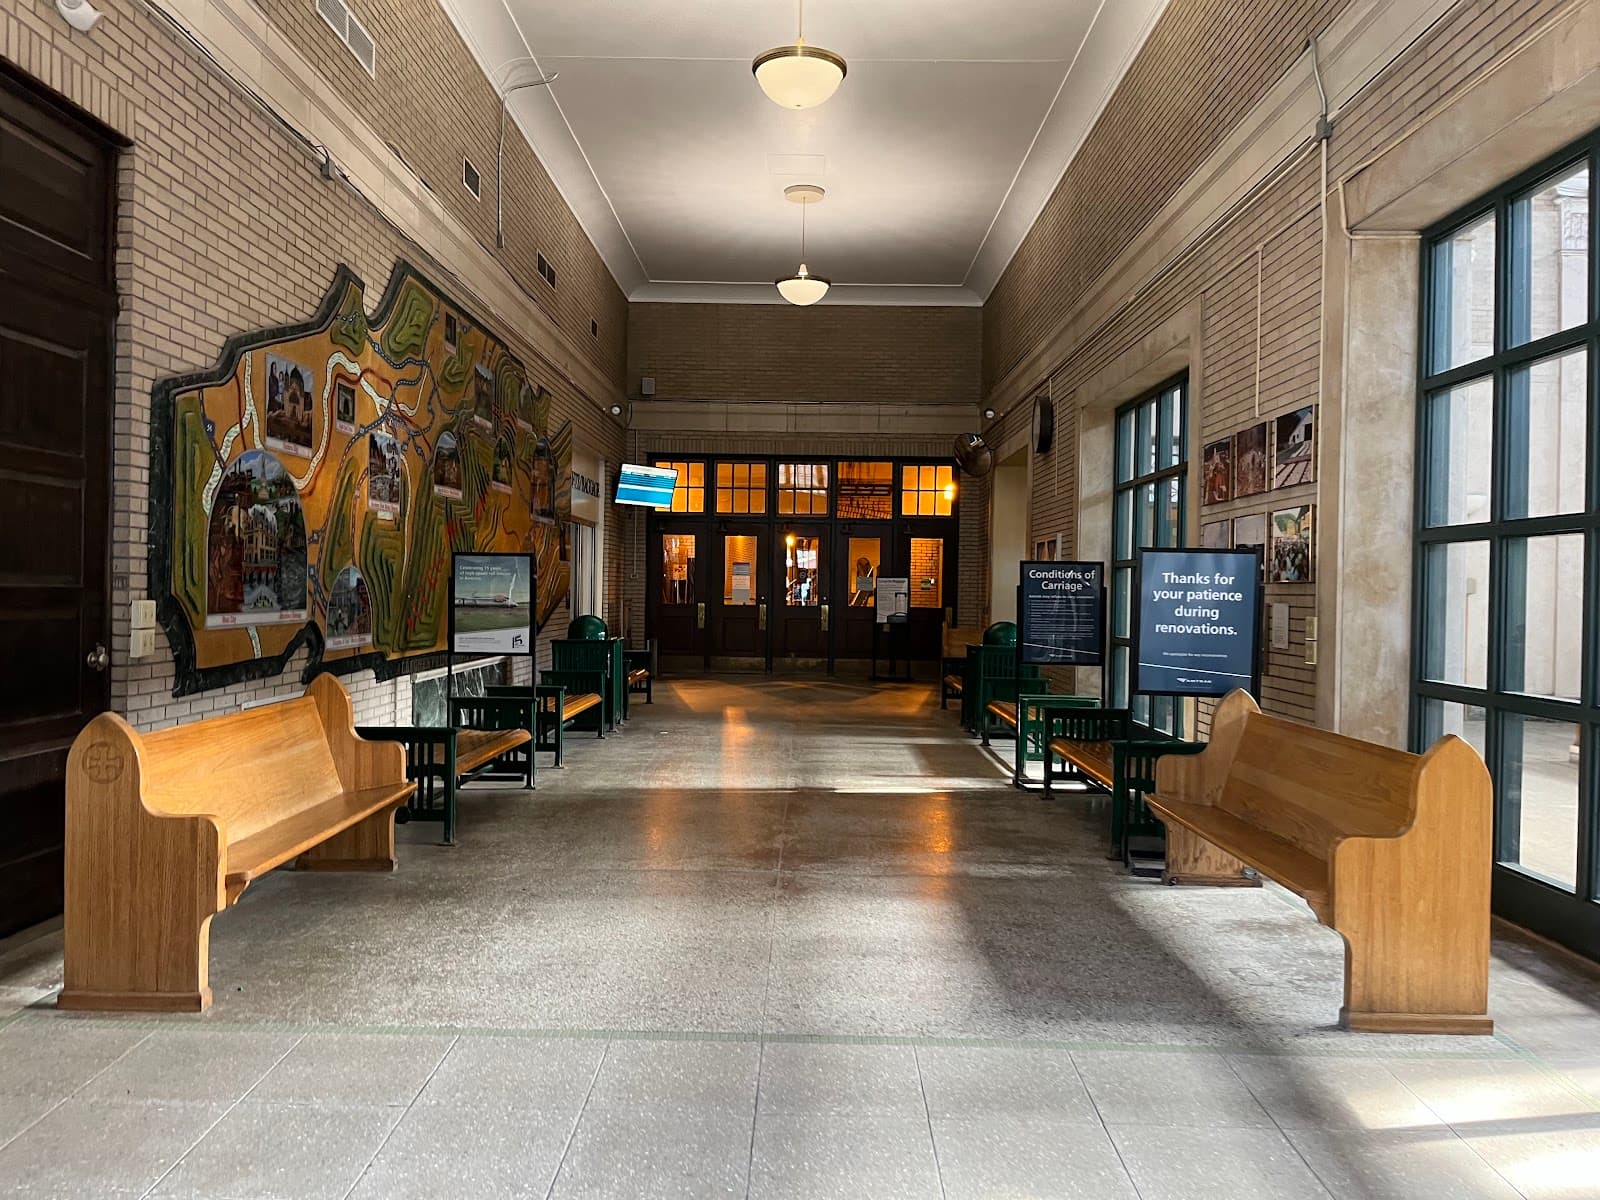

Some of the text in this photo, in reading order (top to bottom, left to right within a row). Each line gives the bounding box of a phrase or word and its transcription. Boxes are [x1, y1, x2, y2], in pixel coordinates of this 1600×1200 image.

[1029, 569, 1096, 579] Conditions of
[1162, 572, 1234, 585] Thanks for
[1041, 581, 1083, 592] Carriage
[1153, 589, 1242, 602] your patience
[1174, 605, 1219, 620] during
[1155, 623, 1238, 635] renovations.
